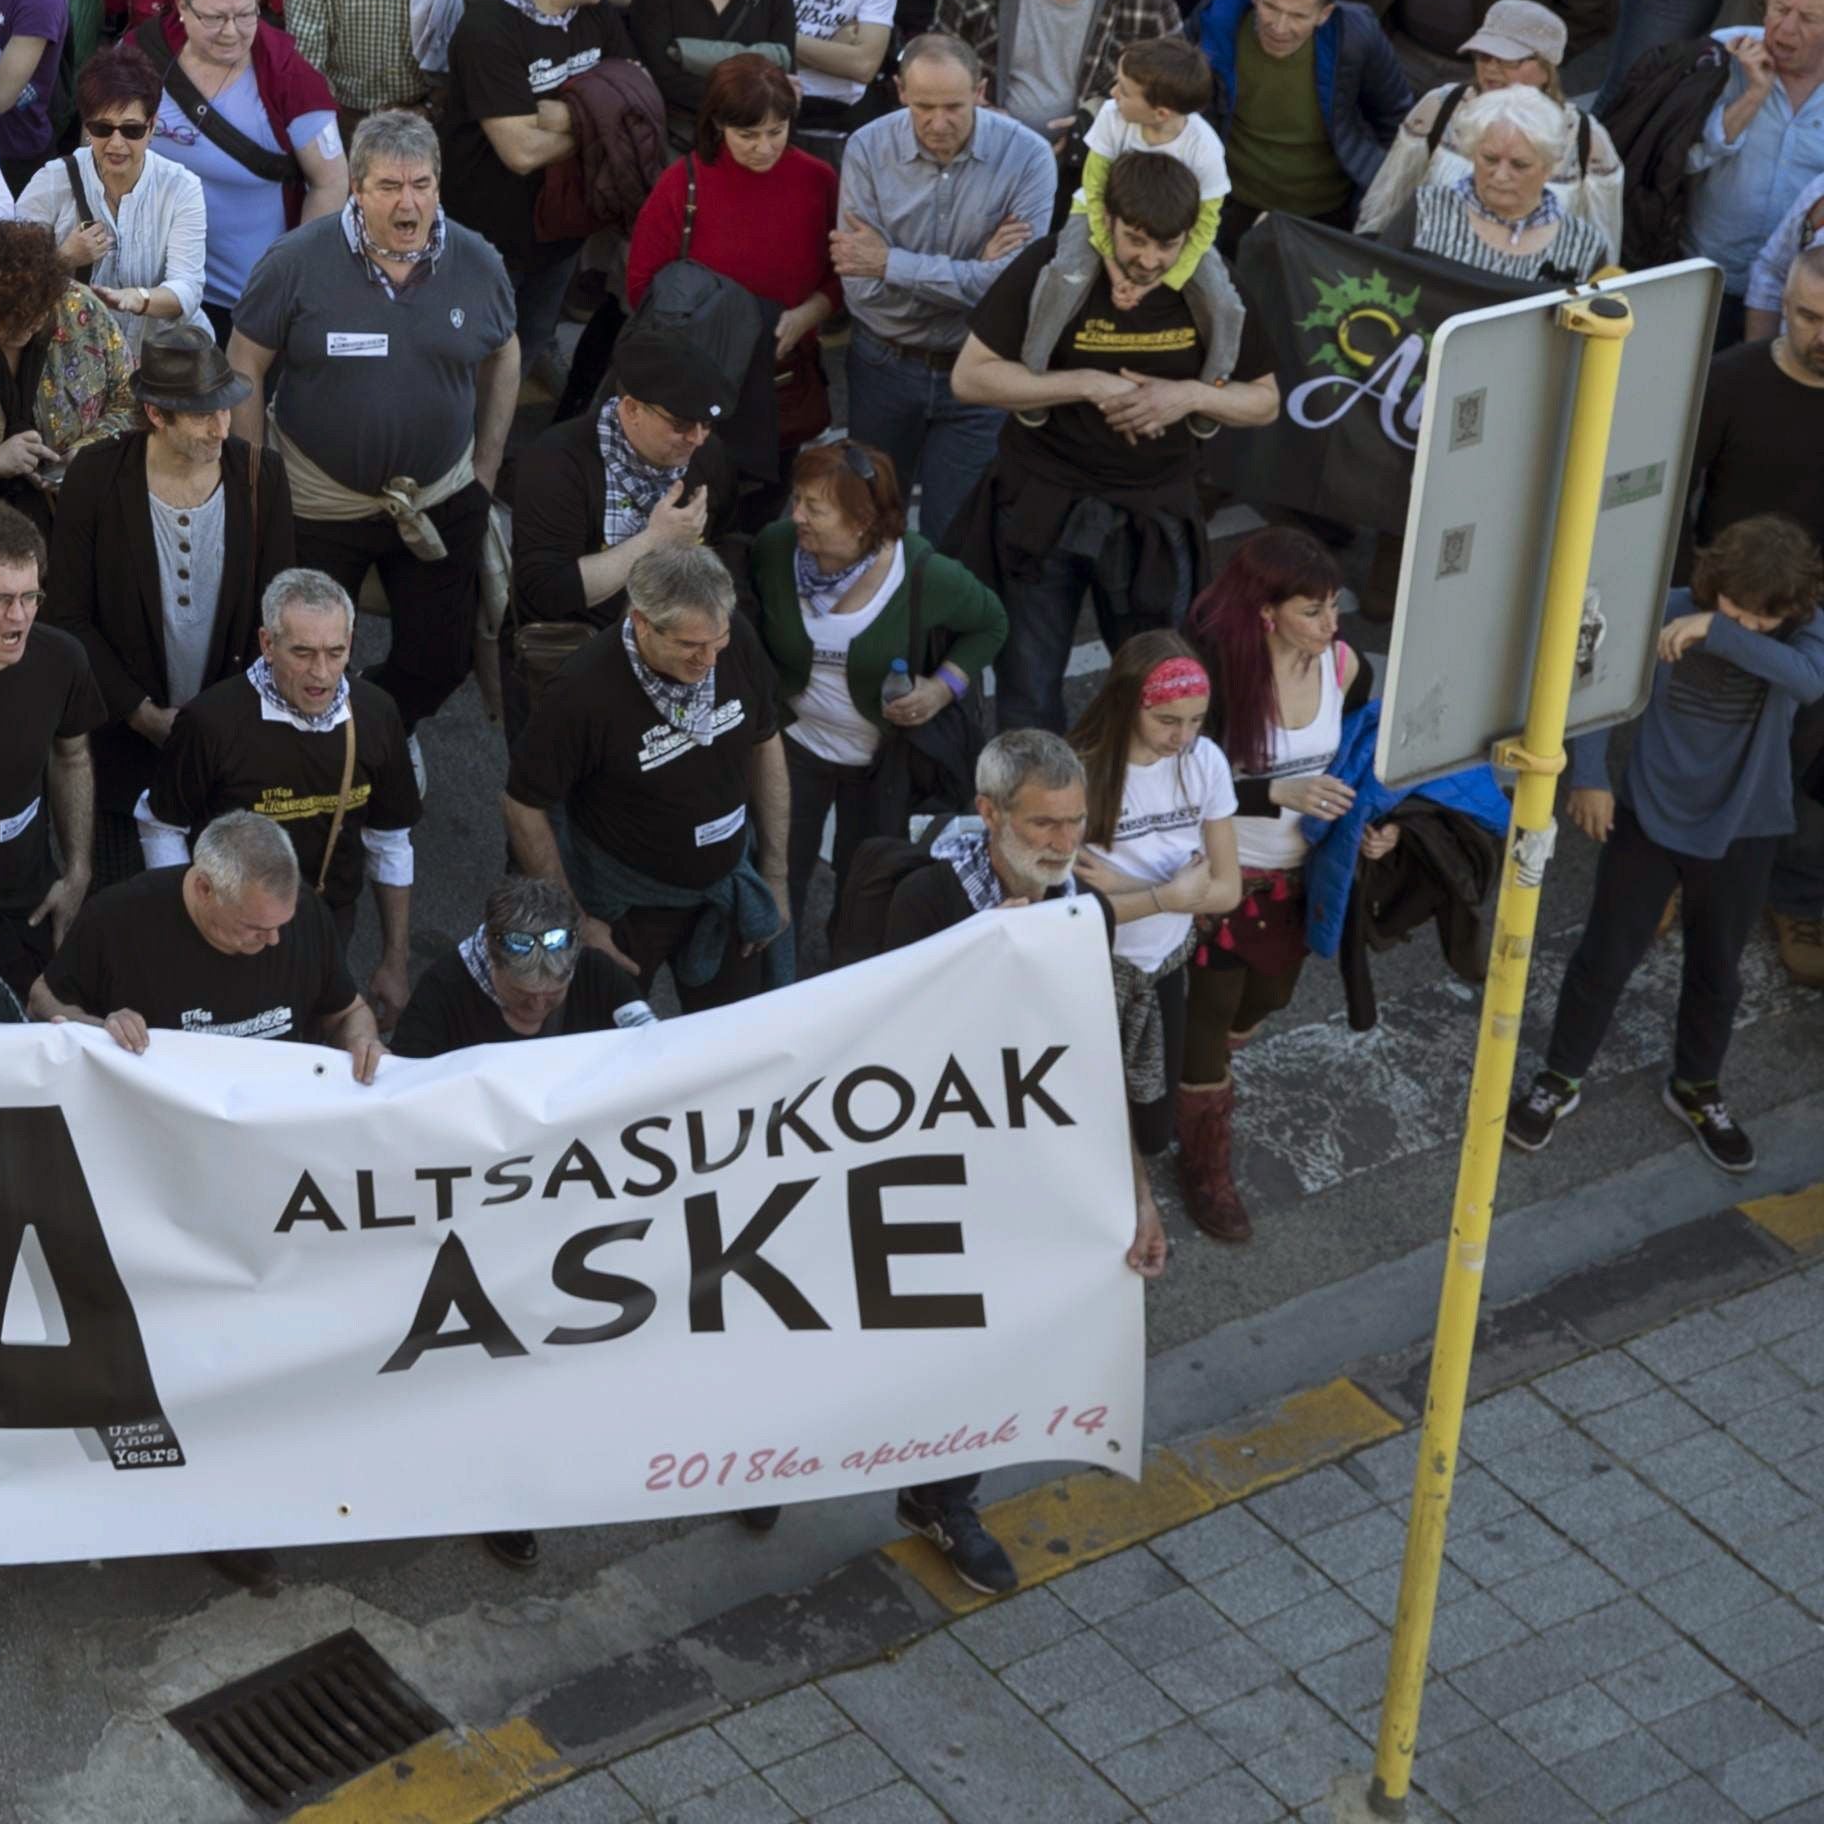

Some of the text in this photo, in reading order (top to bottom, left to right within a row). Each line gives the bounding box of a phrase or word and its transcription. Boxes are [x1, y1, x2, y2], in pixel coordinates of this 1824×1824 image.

[273, 1045, 1078, 1234] ALTSASUKOAK
[376, 1154, 988, 1374] ASKE
[108, 1422, 159, 1437] Urte
[113, 1448, 180, 1466] Years
[645, 1405, 1110, 1491] 2018ko apirilak 14
